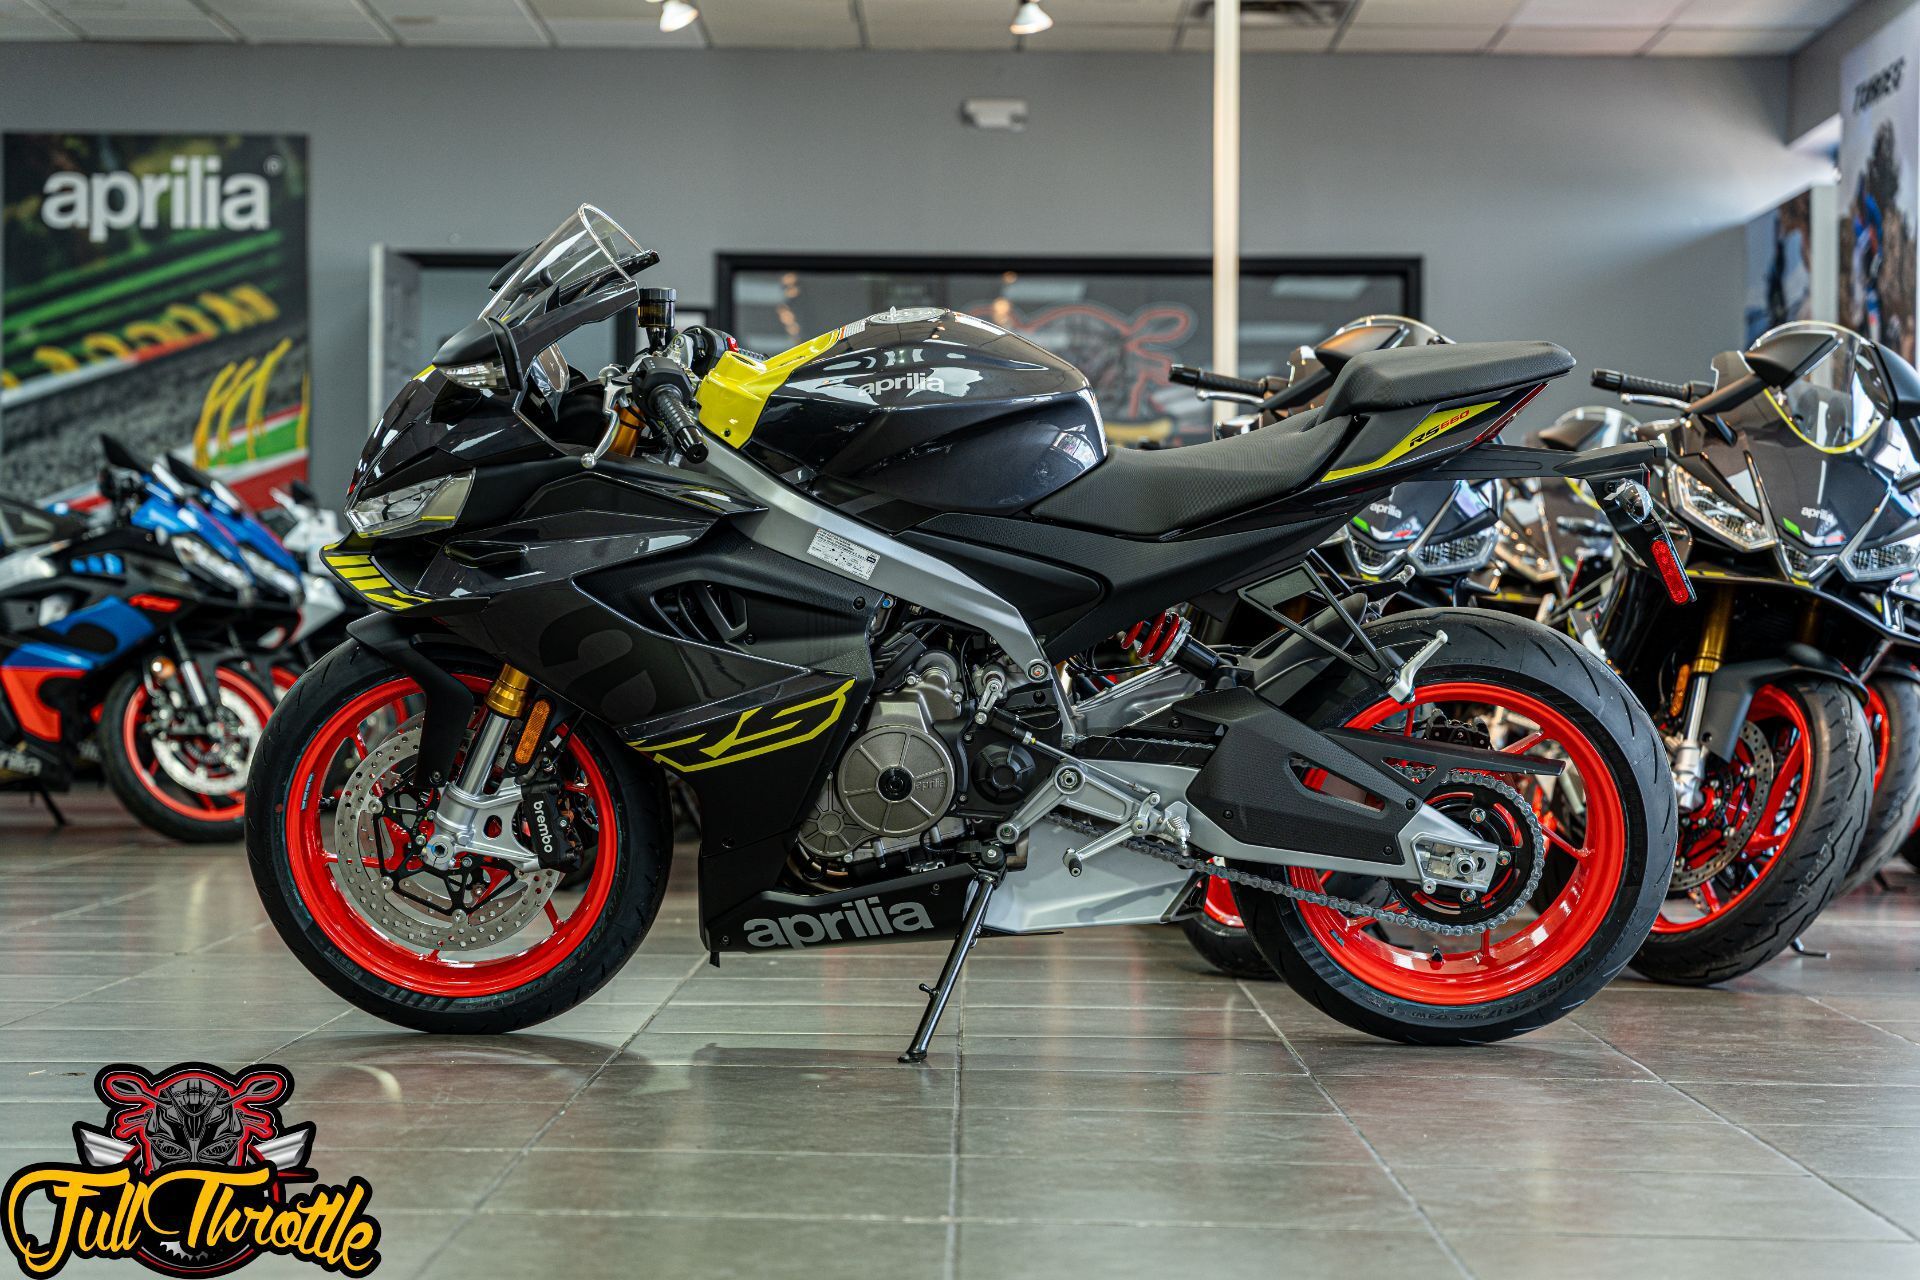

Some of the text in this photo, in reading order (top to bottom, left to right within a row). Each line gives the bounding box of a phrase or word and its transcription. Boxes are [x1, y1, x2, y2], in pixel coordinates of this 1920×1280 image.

[41, 155, 270, 243] aprilia
[857, 372, 945, 397] aprilia
[1369, 502, 1402, 519] aprilia
[1800, 506, 1838, 525] aprilia
[913, 778, 946, 792] aprilia
[533, 800, 553, 853] brembo
[743, 896, 935, 950] aprilia
